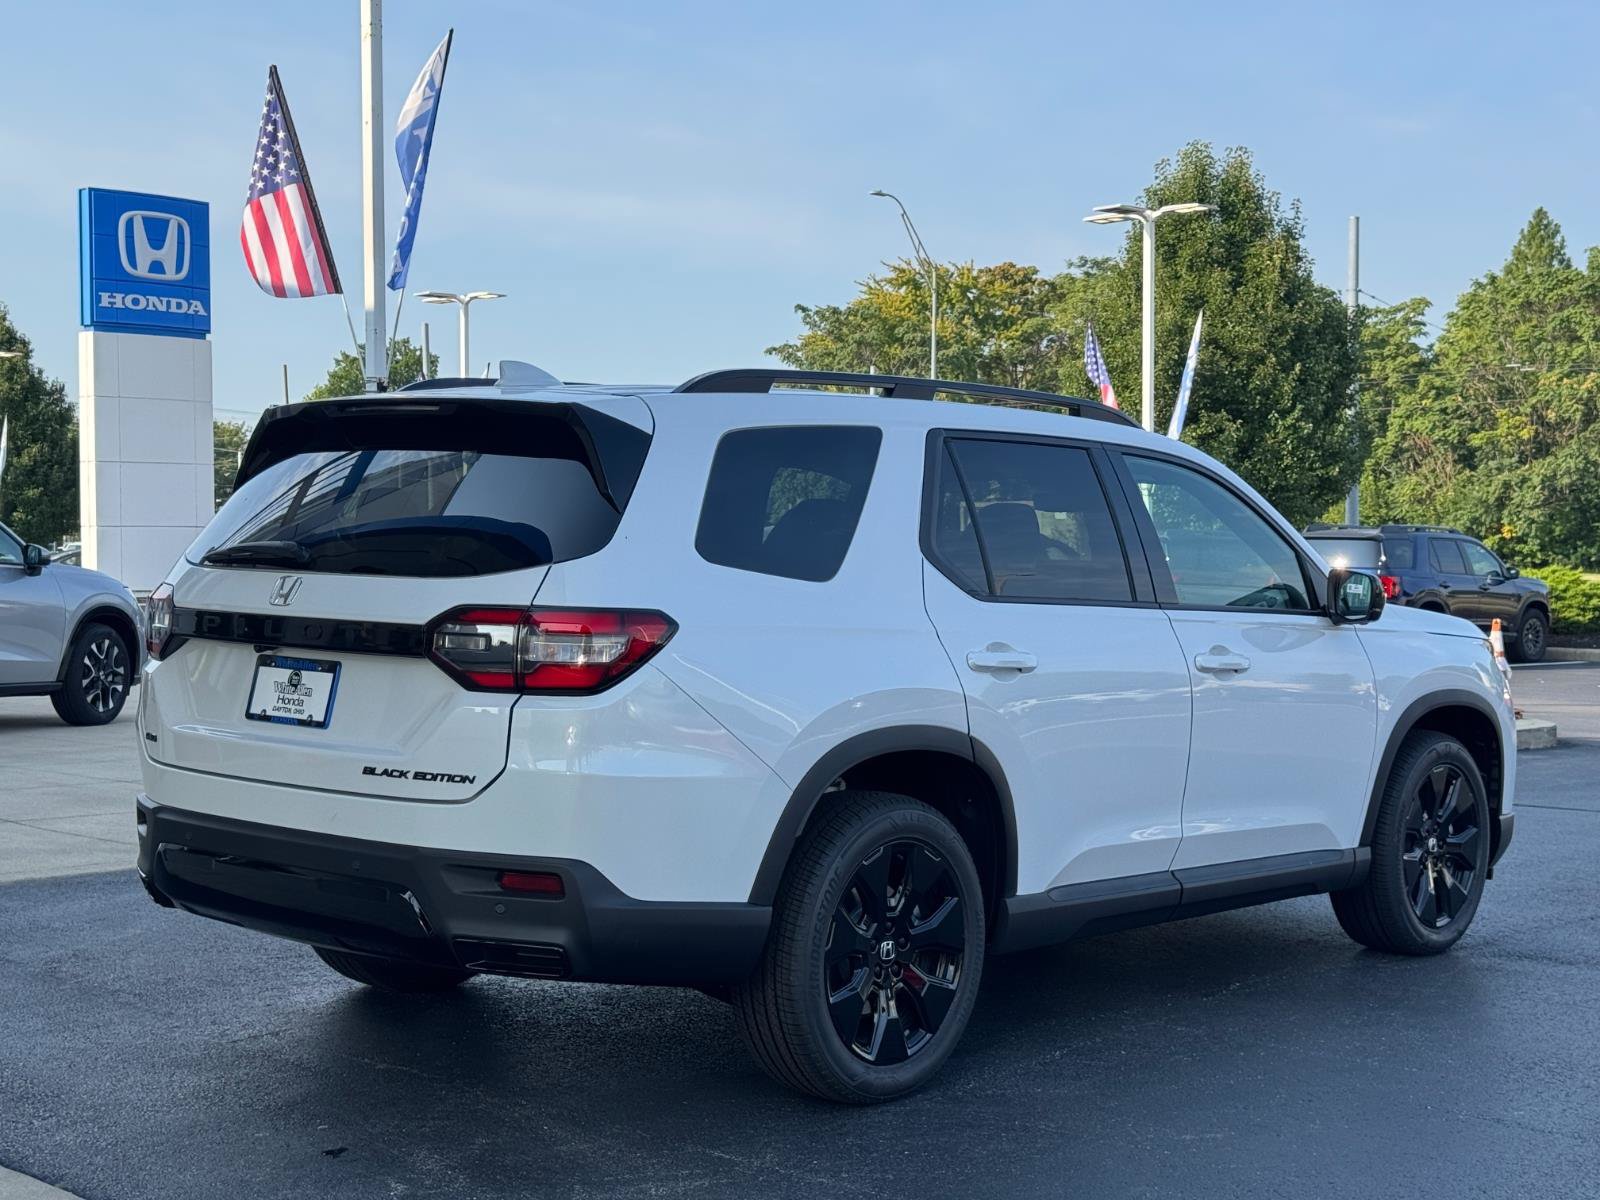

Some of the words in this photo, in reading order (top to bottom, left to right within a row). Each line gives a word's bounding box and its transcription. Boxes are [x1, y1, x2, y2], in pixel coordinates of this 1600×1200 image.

[98, 292, 208, 316] HONDA
[276, 695, 304, 707] Honda
[362, 766, 410, 779] BLACK
[412, 771, 477, 784] EDITION
